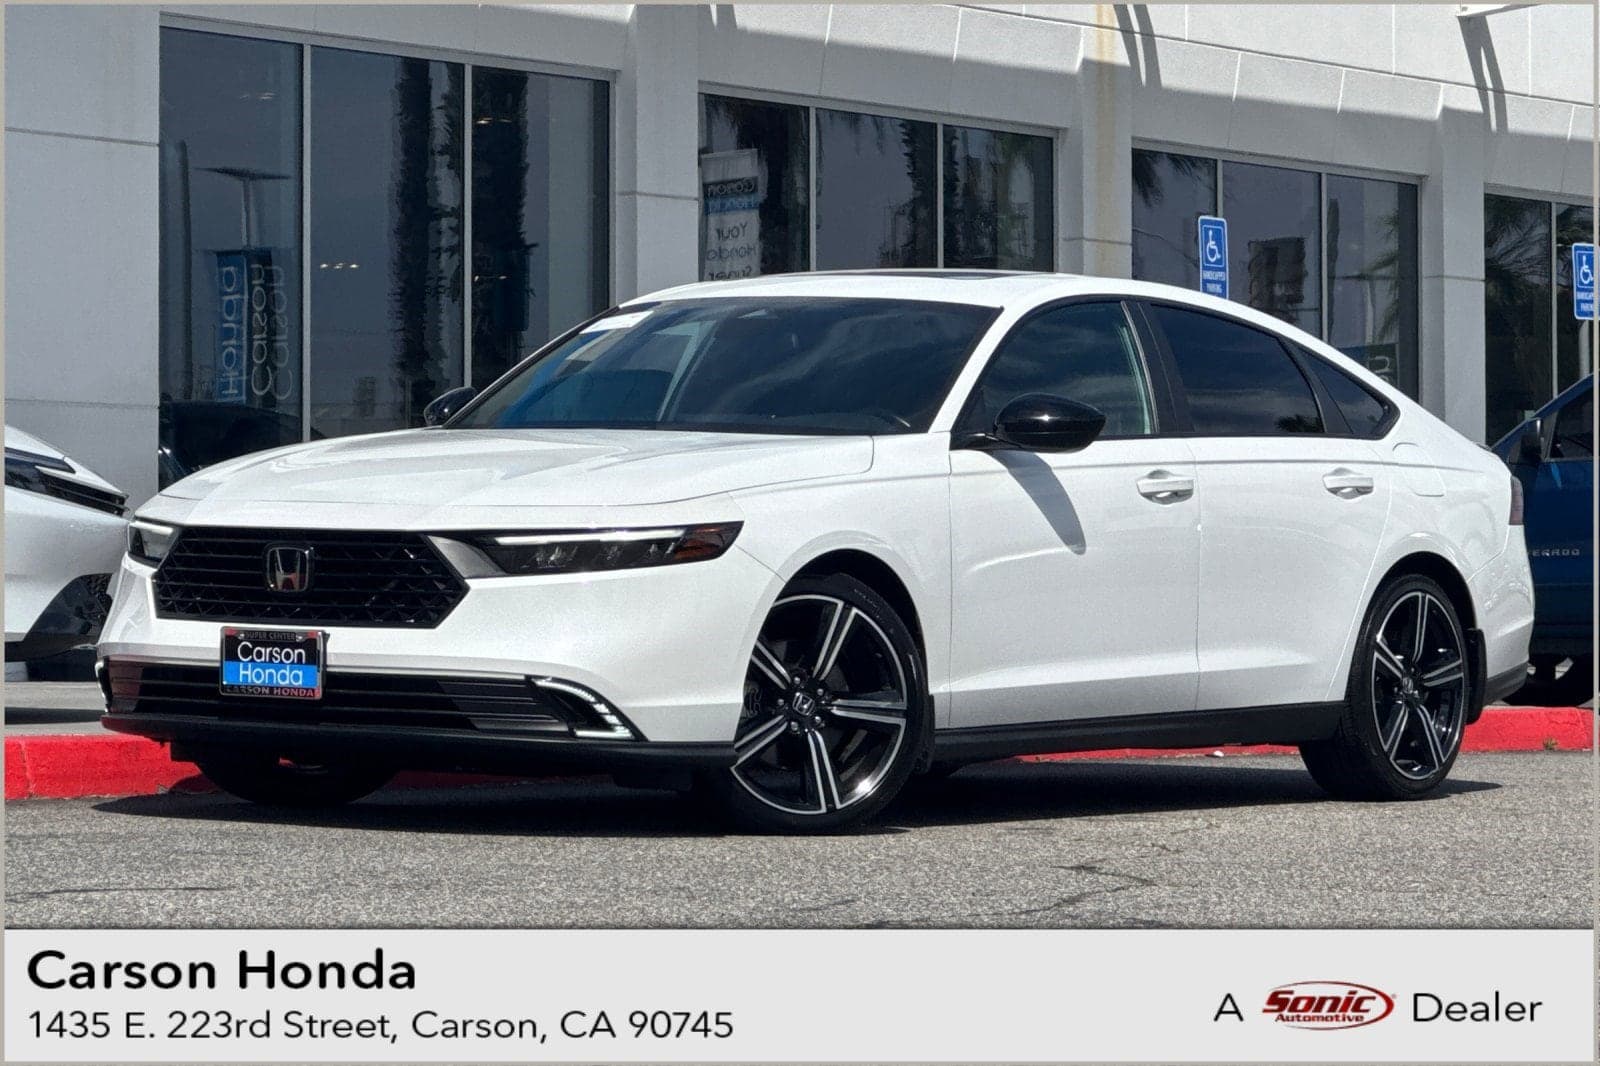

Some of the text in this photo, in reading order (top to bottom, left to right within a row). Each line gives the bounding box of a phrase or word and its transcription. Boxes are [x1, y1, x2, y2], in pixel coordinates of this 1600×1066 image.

[1529, 548, 1580, 557] ERADO
[237, 641, 306, 664] Carson
[239, 662, 304, 685] Honda
[226, 686, 314, 697] CARSON HONDA
